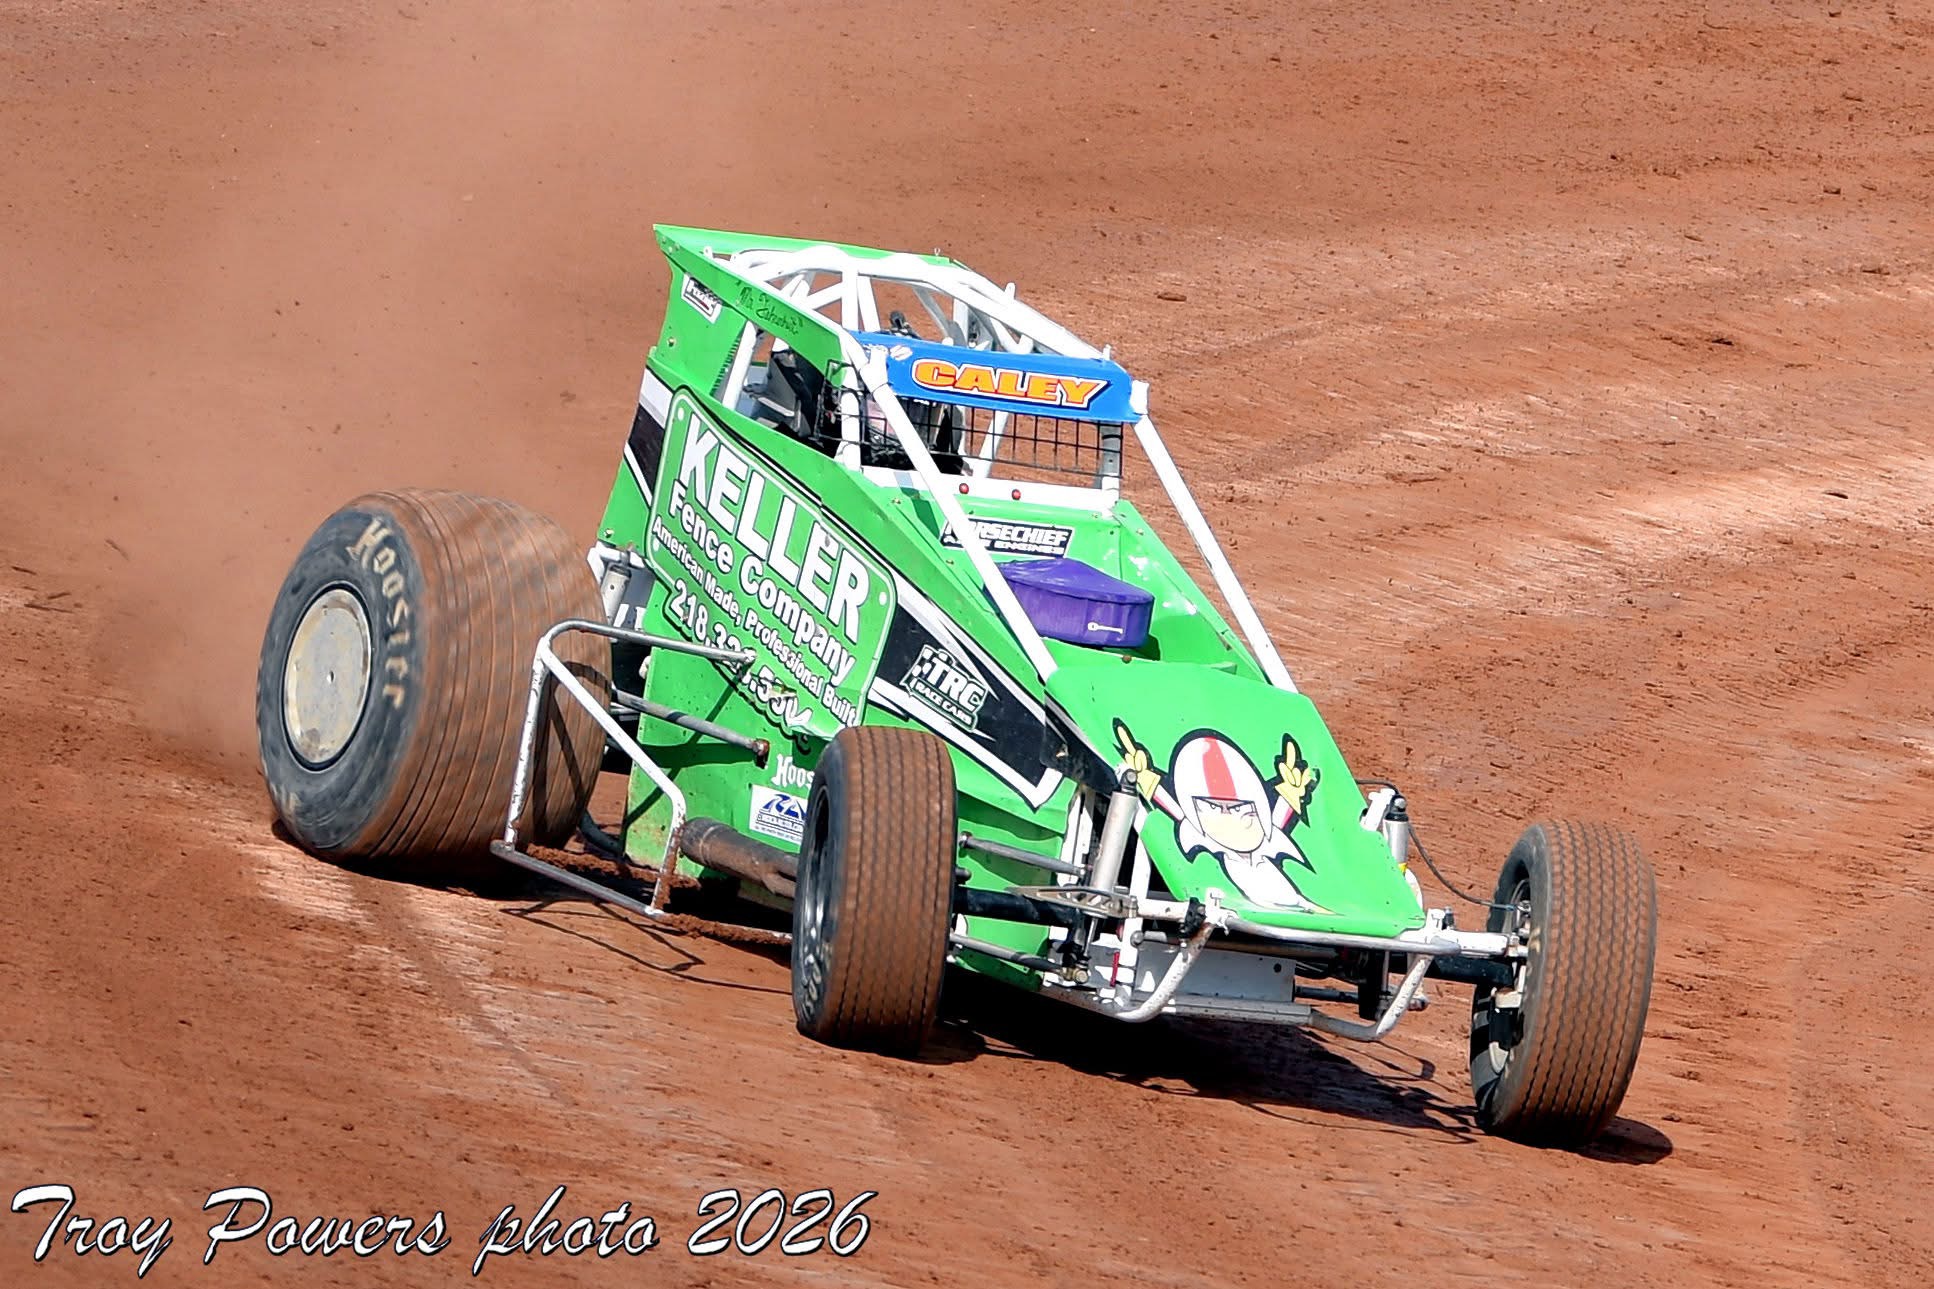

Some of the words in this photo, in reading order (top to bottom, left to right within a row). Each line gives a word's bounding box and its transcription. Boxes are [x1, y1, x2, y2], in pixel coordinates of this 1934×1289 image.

[912, 360, 1103, 407] CALEY
[668, 479, 734, 574] Fence
[739, 553, 856, 687] Company
[679, 412, 870, 645] KELLER
[652, 515, 705, 588] American
[743, 608, 825, 699] Professional
[915, 681, 944, 708] RACE
[927, 655, 985, 714] TRC
